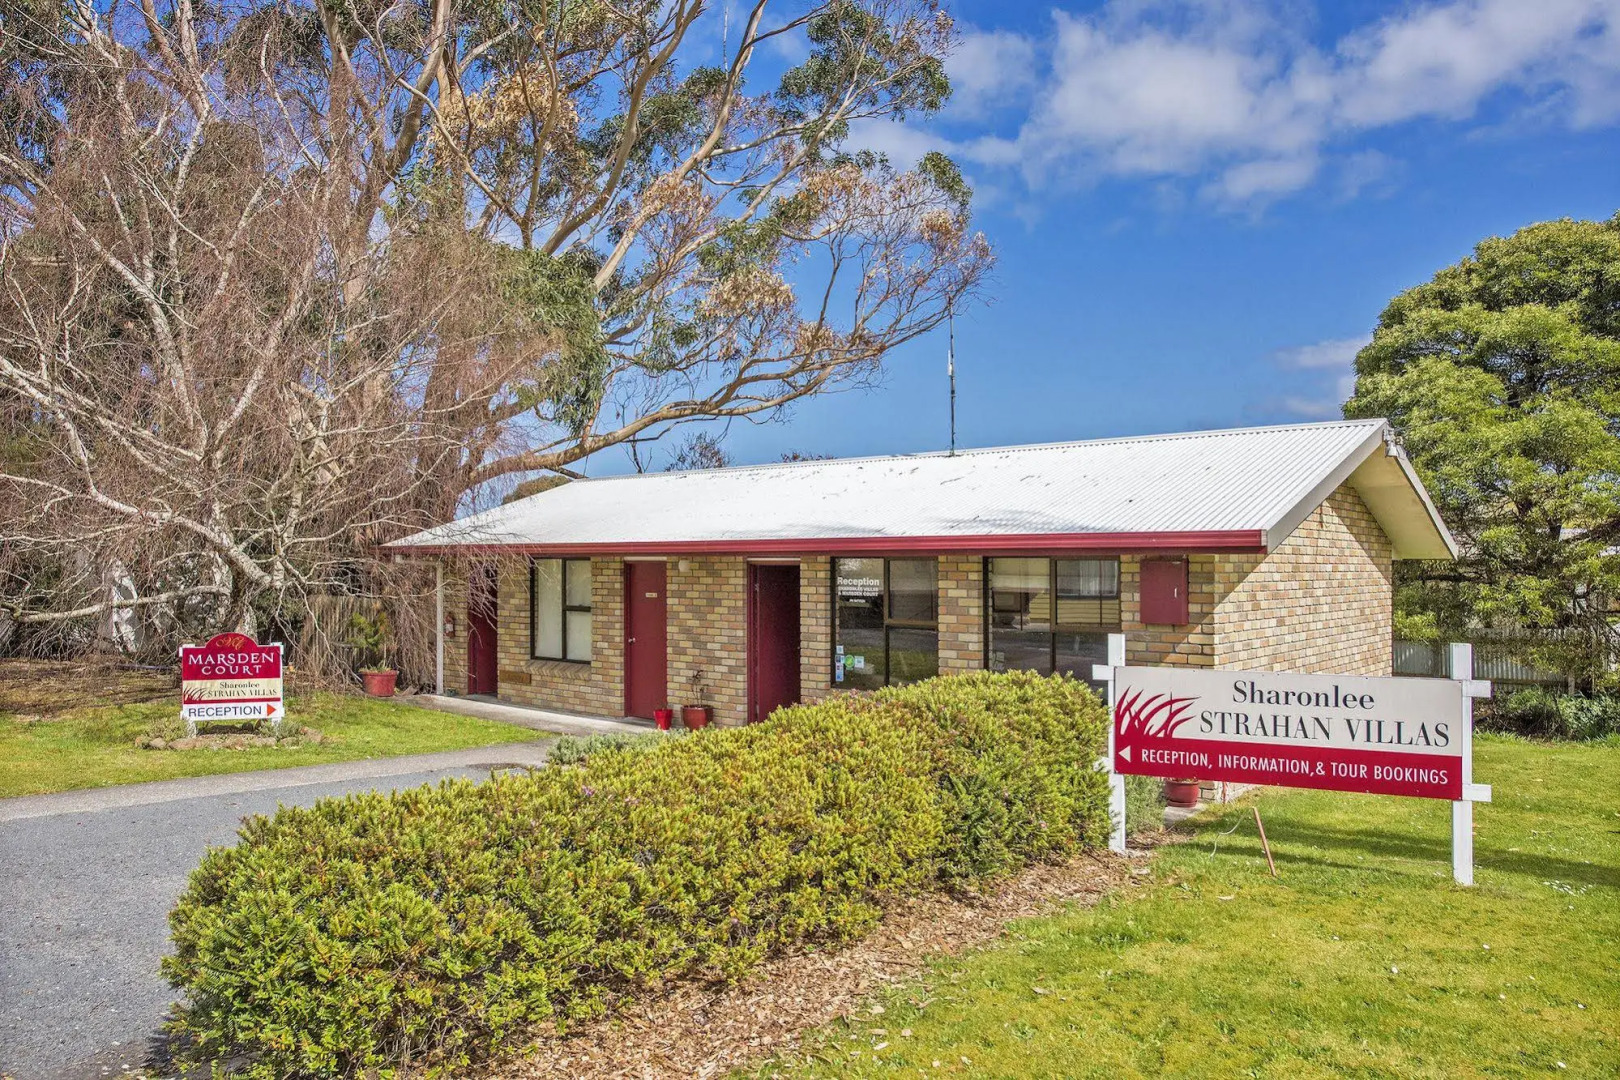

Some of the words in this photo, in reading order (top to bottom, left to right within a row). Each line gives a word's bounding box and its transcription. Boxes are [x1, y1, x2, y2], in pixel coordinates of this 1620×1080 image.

[837, 576, 880, 587] Reception
[188, 652, 274, 667] MARSDEN
[201, 665, 262, 676] COURT
[219, 681, 260, 689] Sharonlee
[207, 689, 248, 698] STRAHAN
[249, 689, 277, 697] VILLAS
[1232, 679, 1375, 710] Sharonlee
[188, 706, 262, 717] RECEPTION
[1200, 710, 1333, 741] STRAHAN
[1344, 717, 1450, 748] VILLAS
[1141, 748, 1213, 770] RECEPTION,
[1330, 761, 1368, 779] TOUR
[1373, 765, 1448, 785] BOOKINGS
